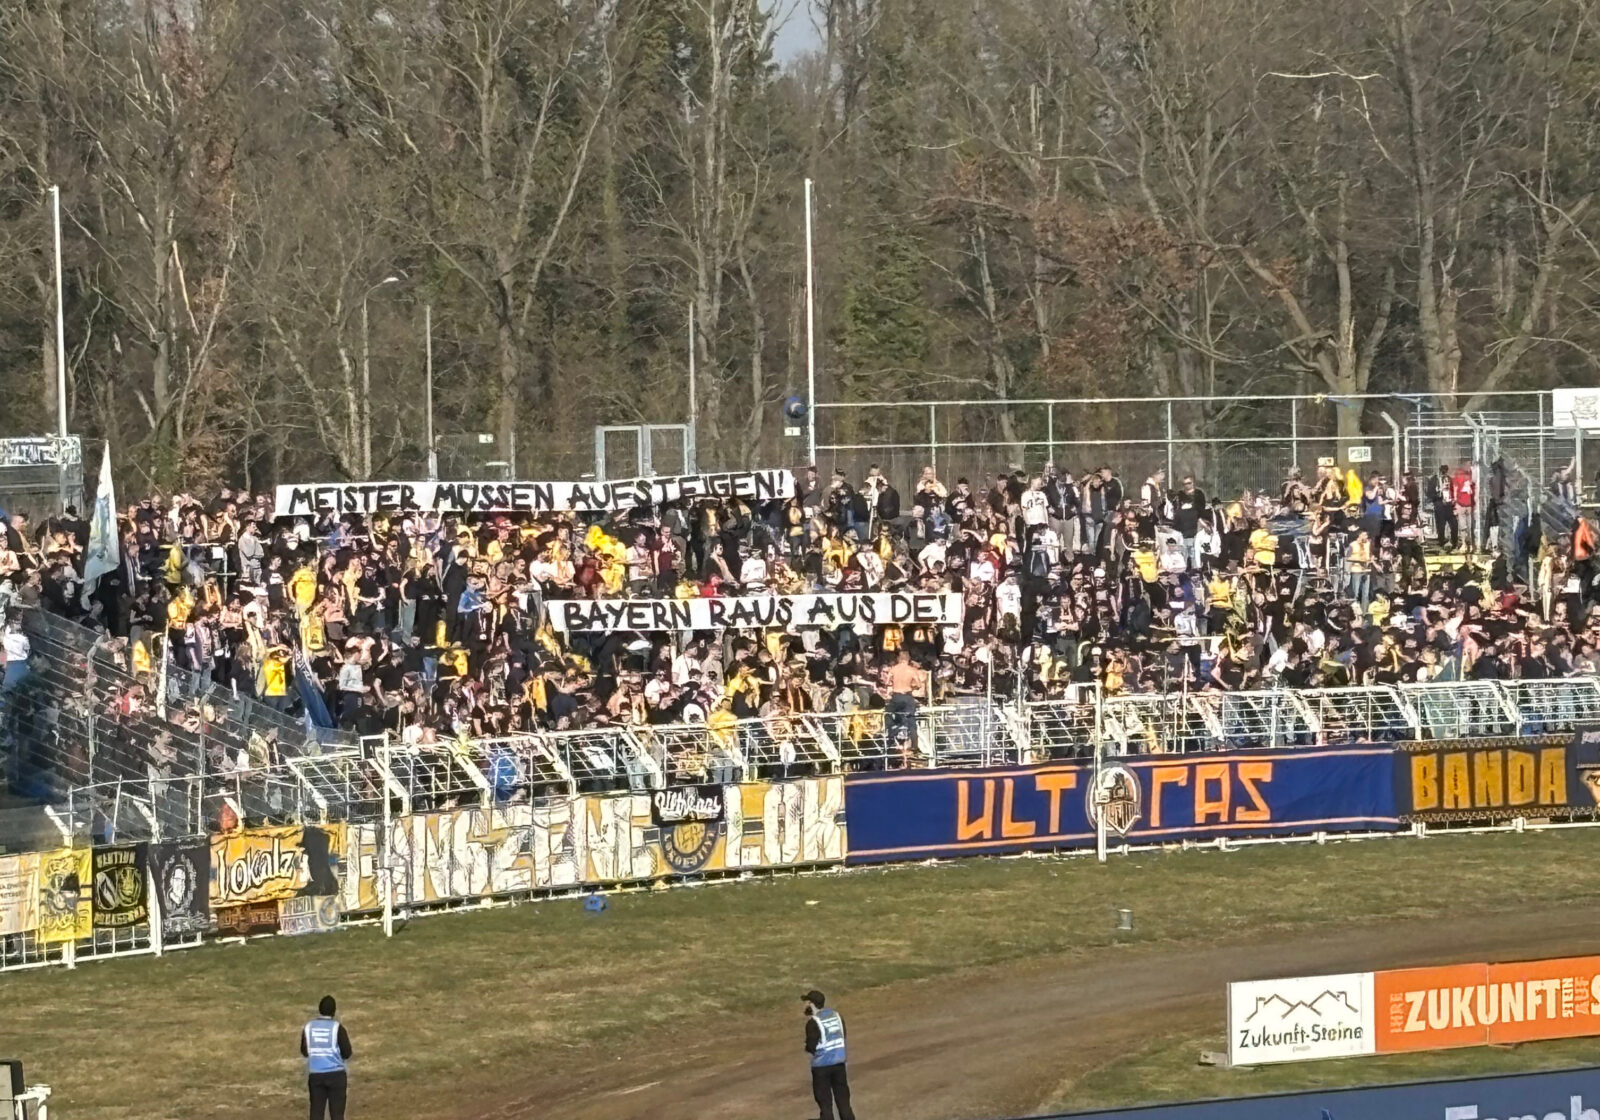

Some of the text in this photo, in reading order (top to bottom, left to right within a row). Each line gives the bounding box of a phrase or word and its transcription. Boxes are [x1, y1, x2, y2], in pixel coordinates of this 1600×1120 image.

[288, 484, 421, 514] MEISTER
[568, 470, 785, 510] AUFSTEIGEN!
[563, 594, 948, 630] BAYERN RAUS AUS DE!
[1411, 747, 1567, 811] BANDA
[723, 778, 843, 868] LOK
[1404, 978, 1561, 1032] ZUKUNFT
[1239, 1021, 1364, 1048] Zukunft-Steine
